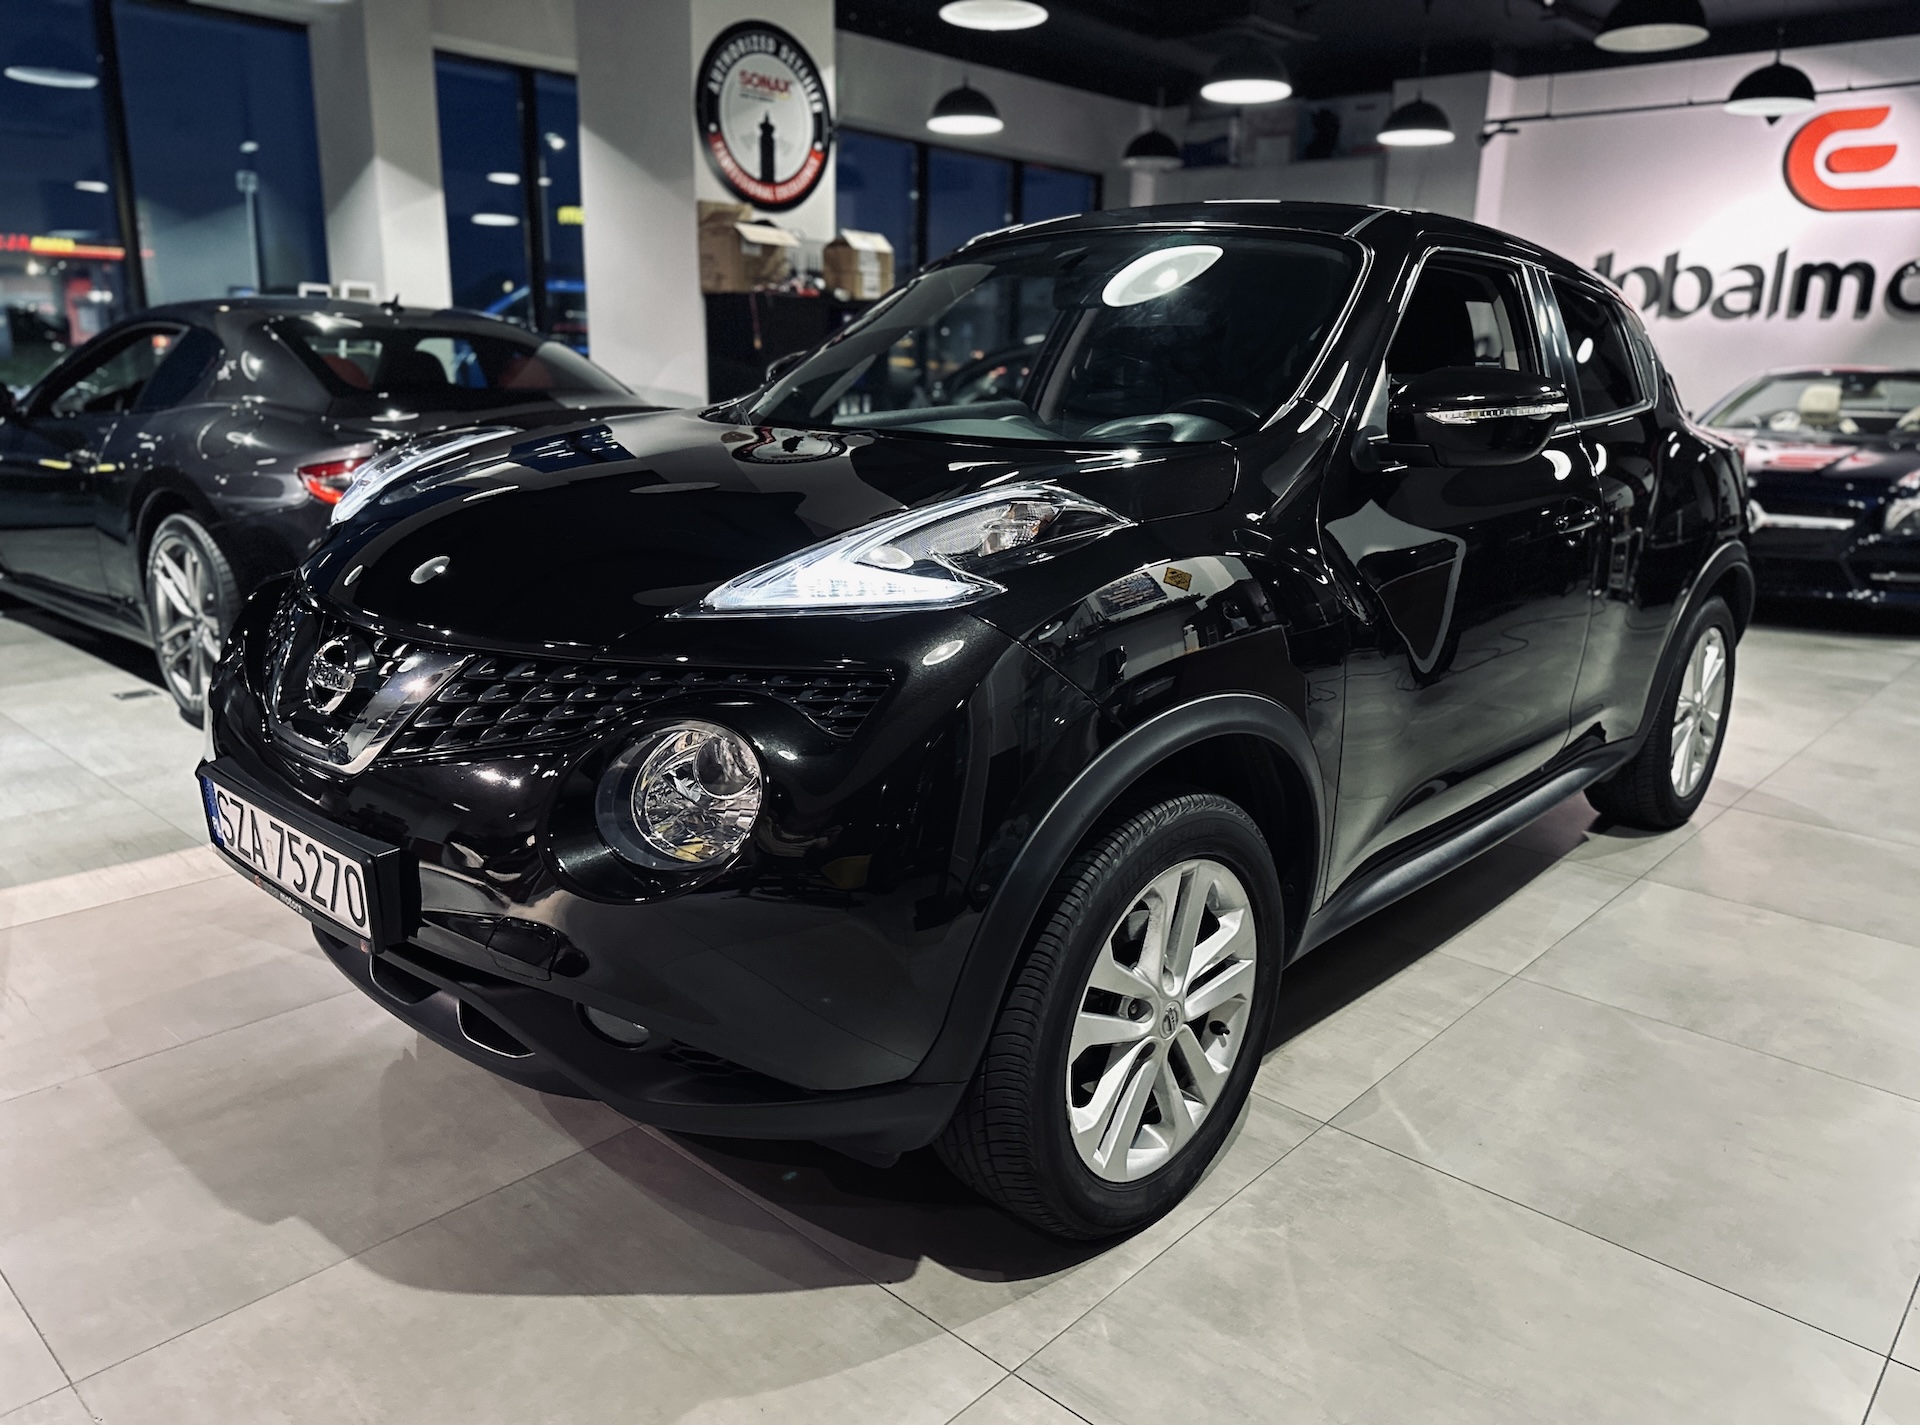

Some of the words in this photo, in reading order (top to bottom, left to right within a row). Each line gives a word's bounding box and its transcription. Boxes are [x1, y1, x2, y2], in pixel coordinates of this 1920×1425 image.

[738, 69, 793, 93] SONAX
[217, 790, 268, 871] SZA
[269, 819, 367, 929] 75270
